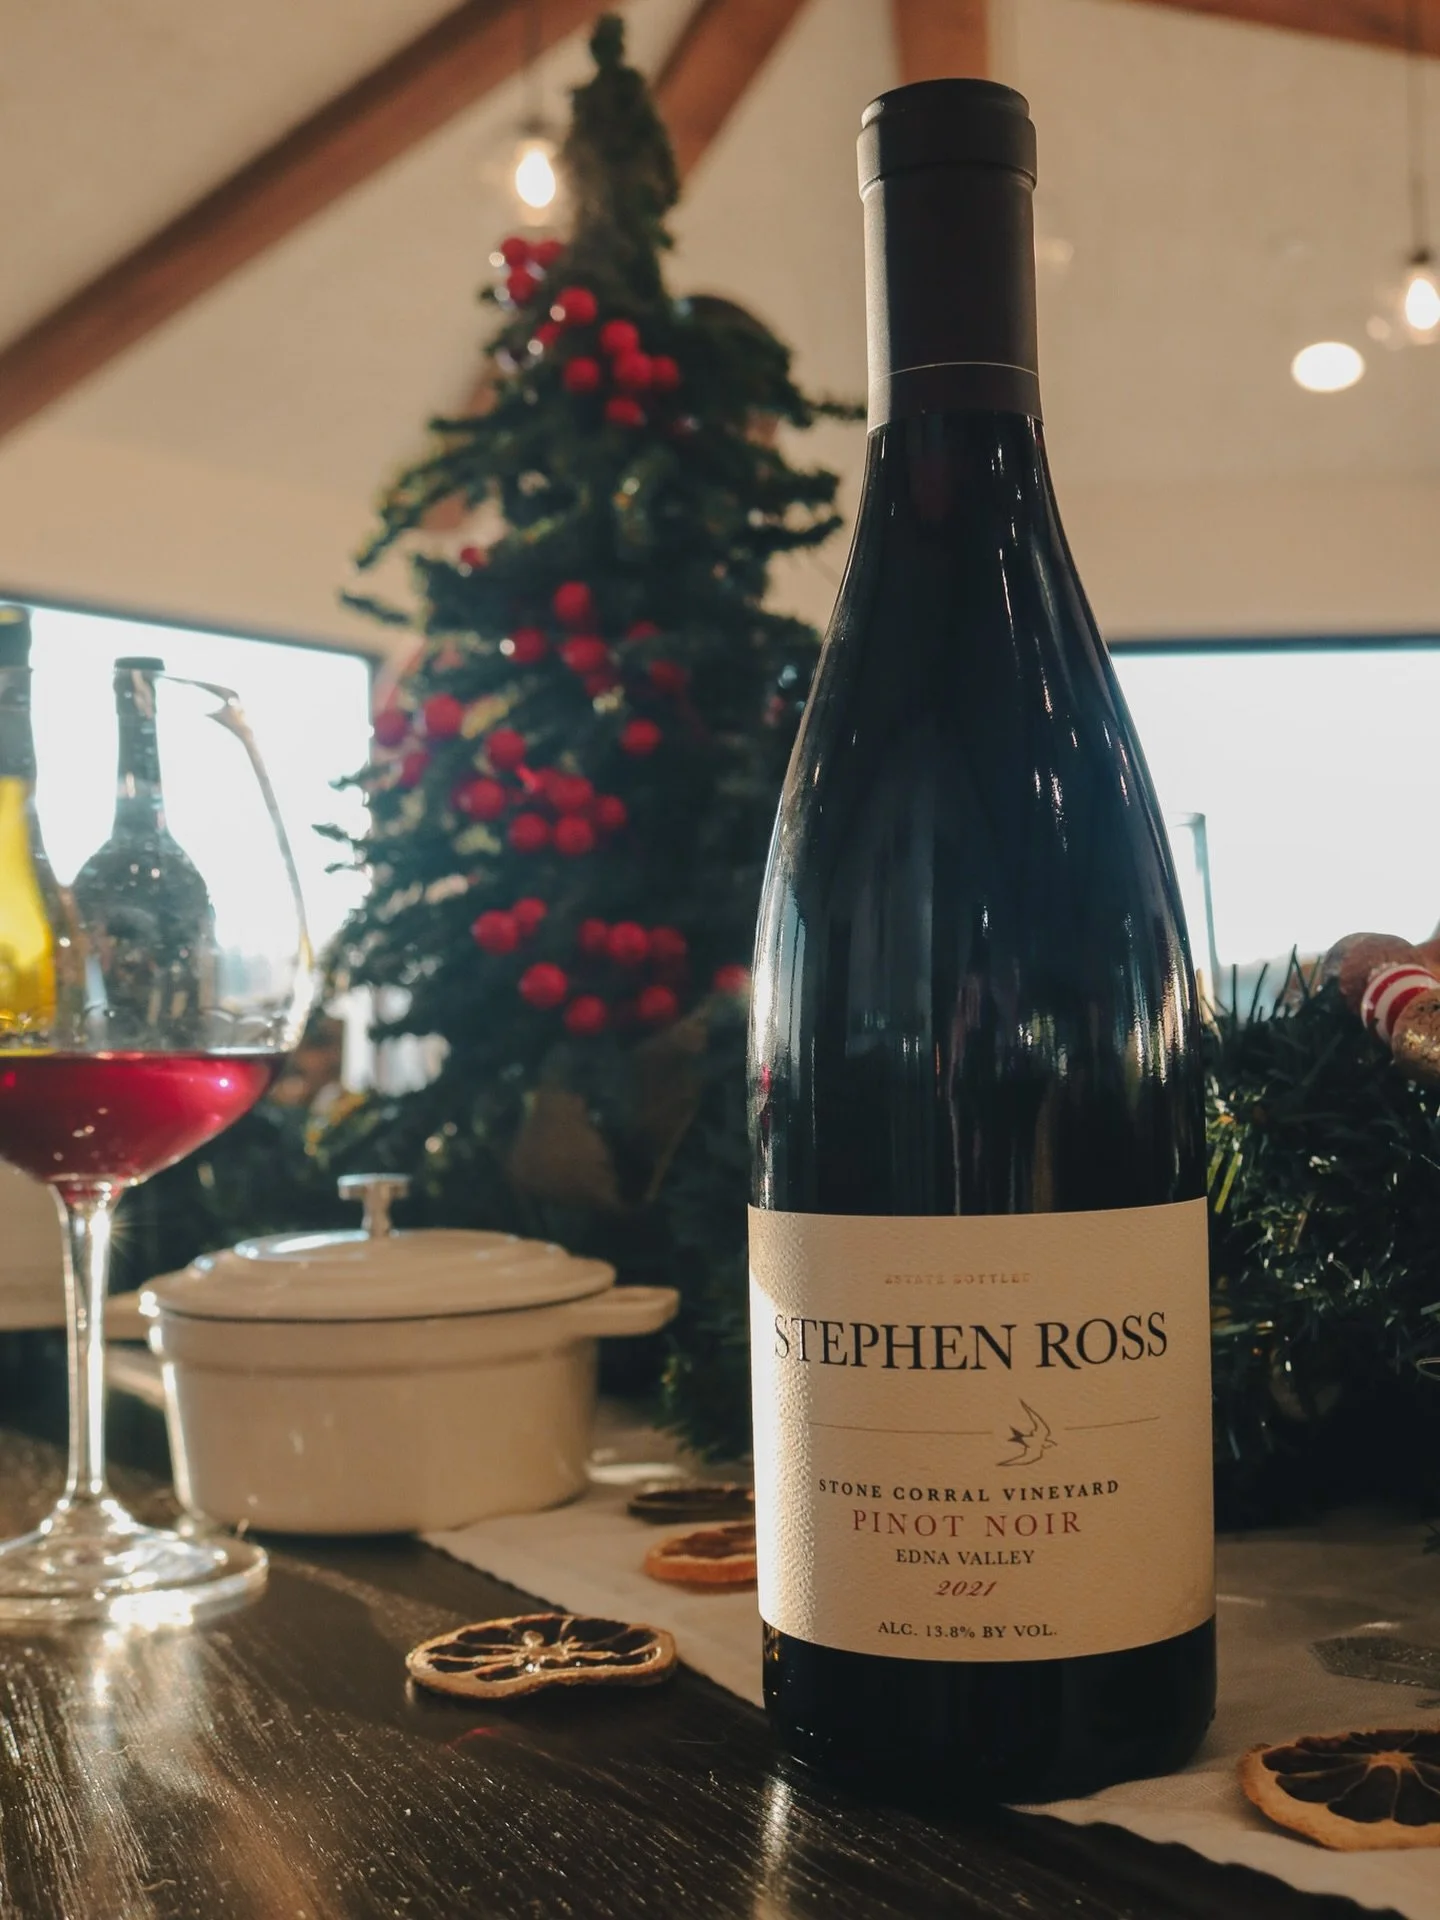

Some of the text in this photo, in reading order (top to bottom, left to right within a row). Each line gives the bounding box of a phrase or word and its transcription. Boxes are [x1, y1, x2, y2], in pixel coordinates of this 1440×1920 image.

[774, 1311, 1168, 1370] STEPHEN ROSS
[818, 1478, 1120, 1502] STONE CORRAL VINEYARD
[852, 1509, 1082, 1538] PINOT NOIR
[896, 1549, 1035, 1566] EDNA VALLEY
[935, 1580, 998, 1597] 2021
[878, 1621, 1058, 1639] ALC. 13.8% BY VOL.
